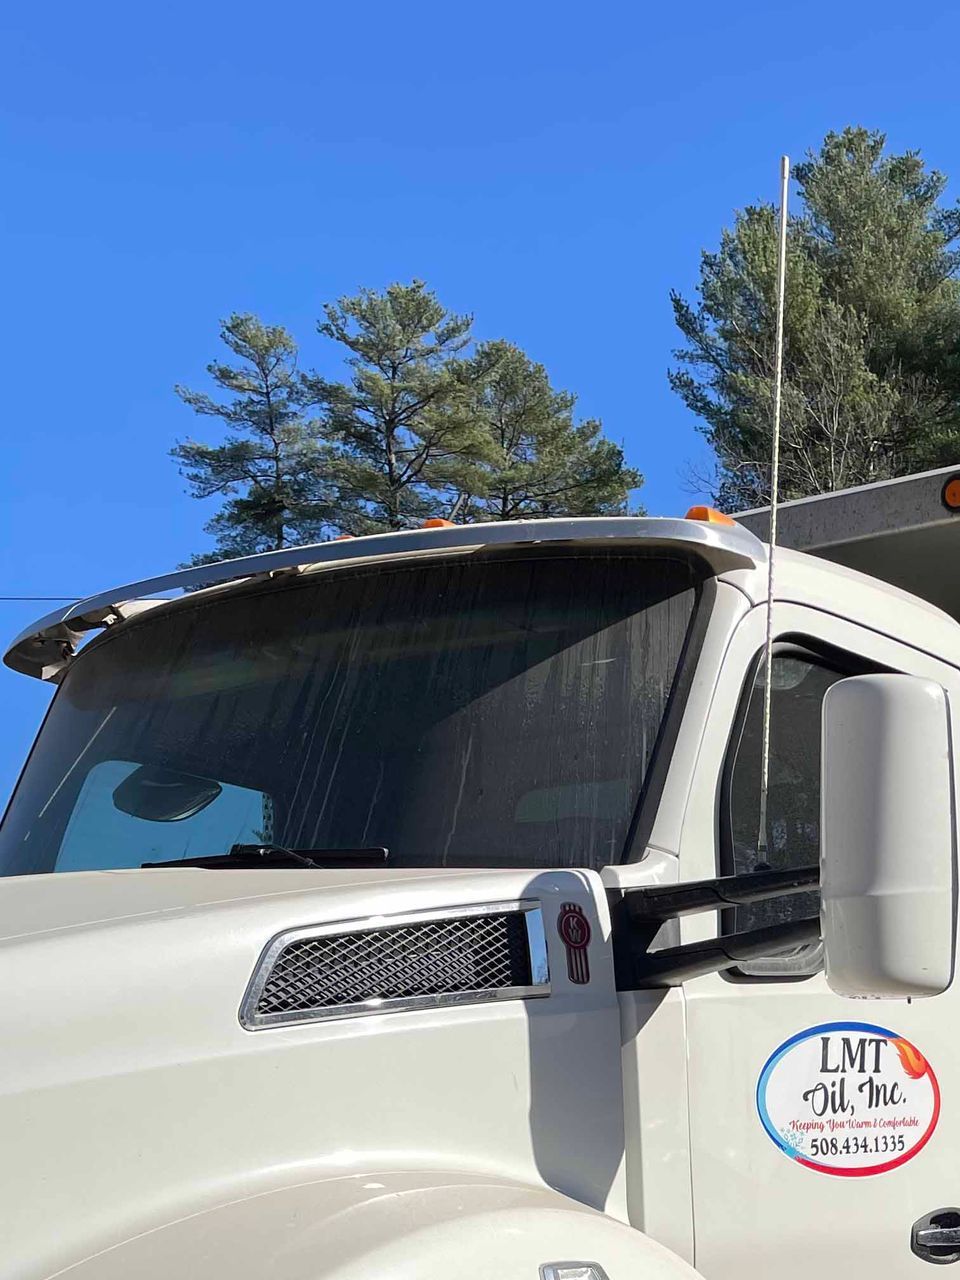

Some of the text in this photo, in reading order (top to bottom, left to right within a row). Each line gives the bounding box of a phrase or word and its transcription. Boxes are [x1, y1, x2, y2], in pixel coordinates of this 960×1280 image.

[819, 1036, 888, 1073] LMT
[802, 1076, 907, 1117] Oil, Inc.
[789, 1119, 825, 1133] Keeping
[826, 1118, 845, 1132] You
[846, 1119, 872, 1129] Warm
[878, 1117, 920, 1130] Comfortable
[810, 1134, 905, 1156] 508.434.1335
